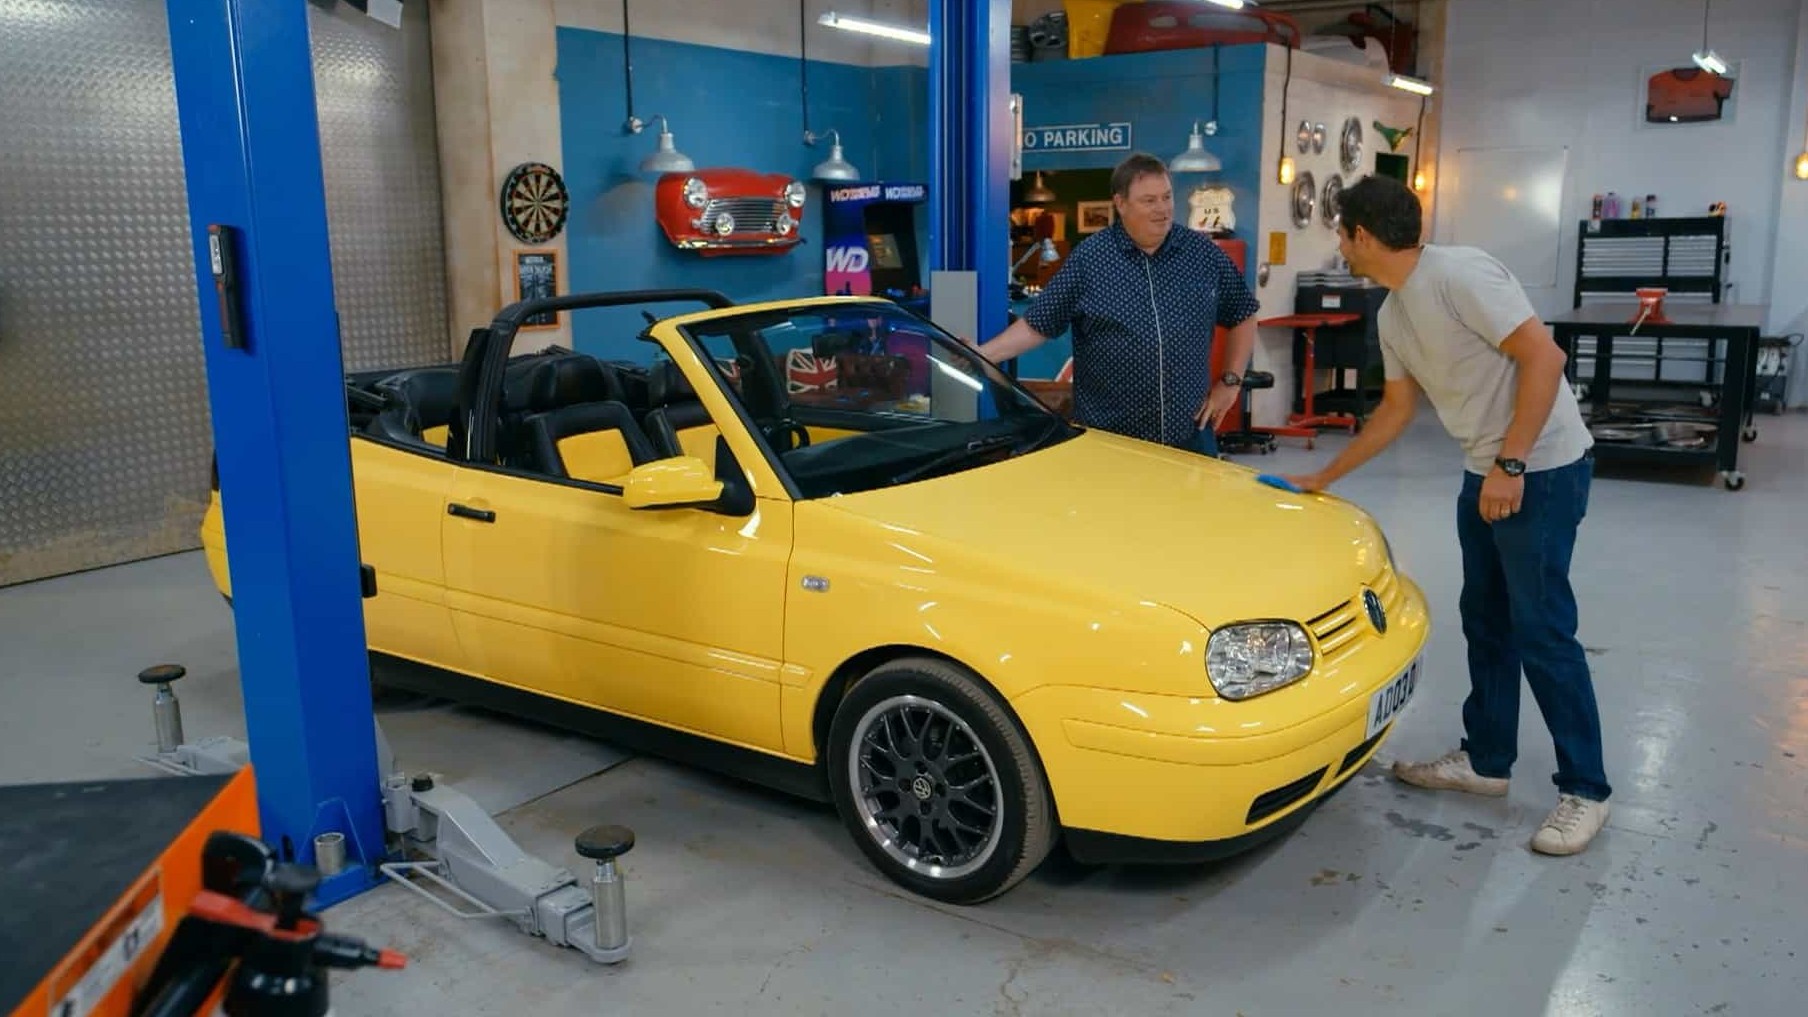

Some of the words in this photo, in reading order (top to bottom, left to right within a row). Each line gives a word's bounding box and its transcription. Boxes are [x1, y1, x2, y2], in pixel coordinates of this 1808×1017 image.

[1023, 132, 1037, 148] O
[1043, 128, 1123, 147] PARKING
[826, 246, 868, 273] WD
